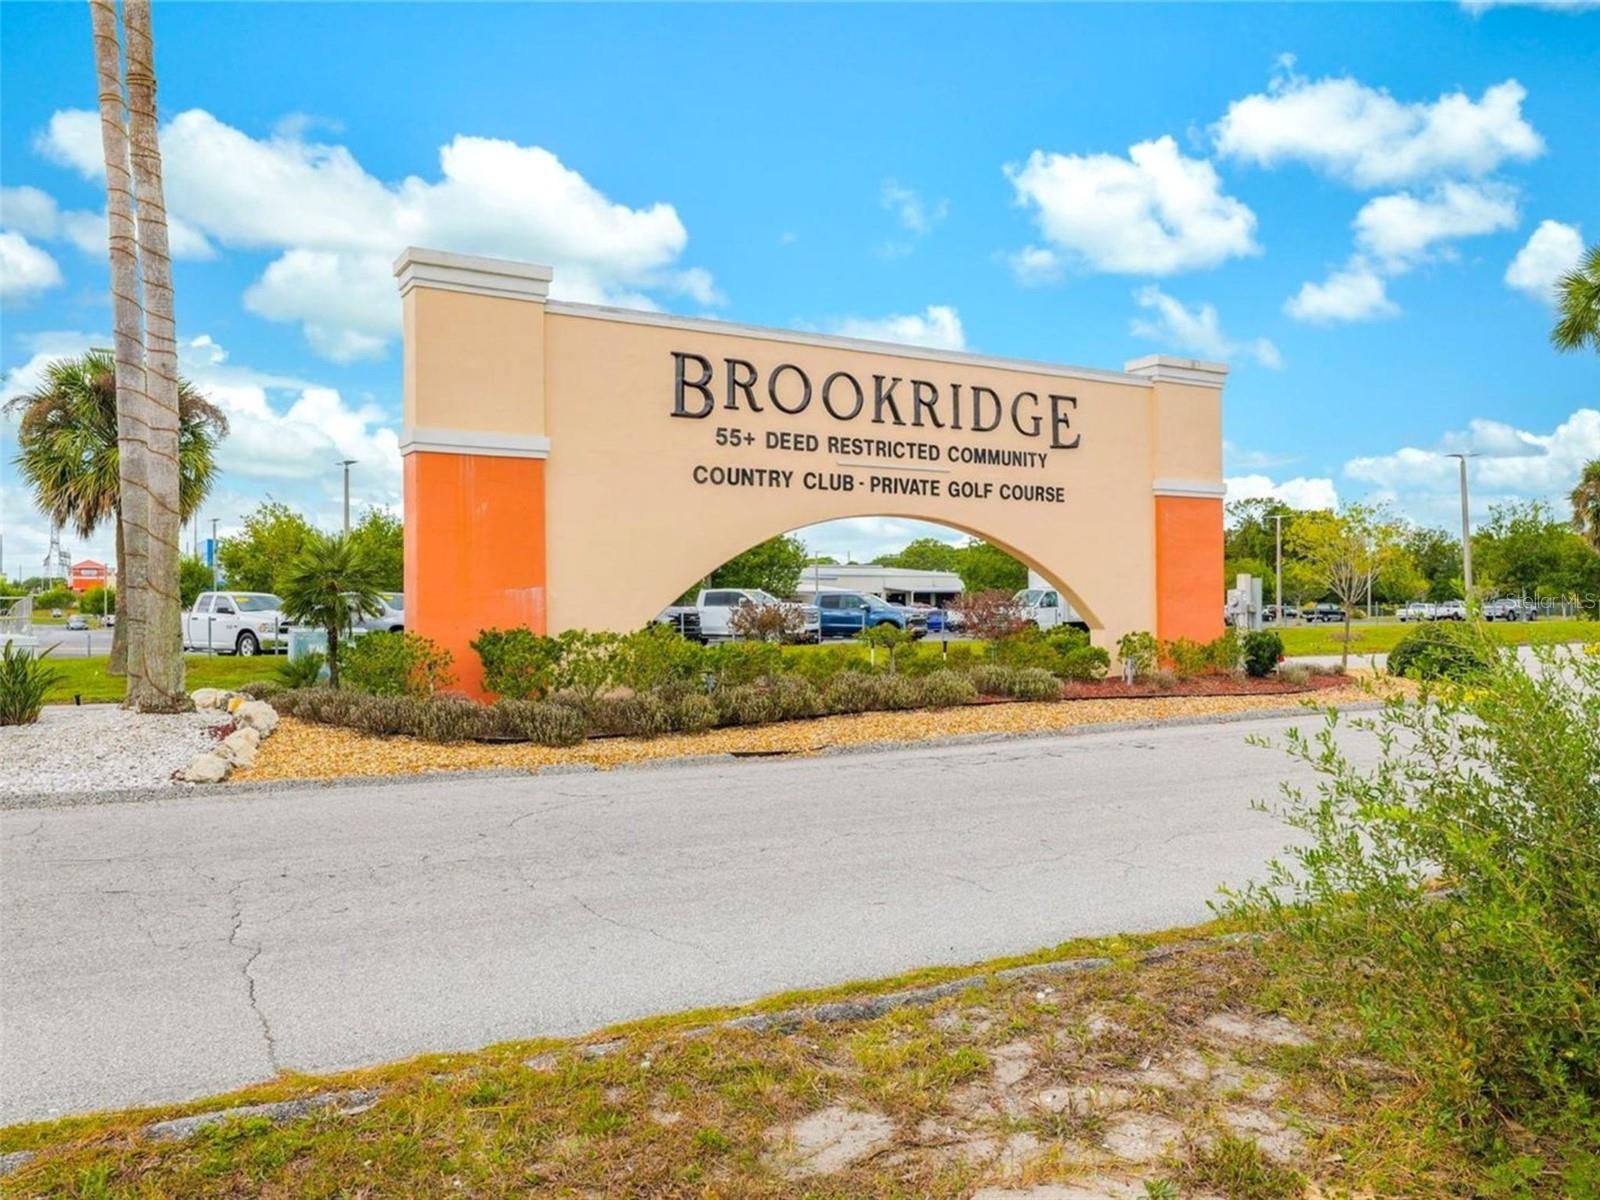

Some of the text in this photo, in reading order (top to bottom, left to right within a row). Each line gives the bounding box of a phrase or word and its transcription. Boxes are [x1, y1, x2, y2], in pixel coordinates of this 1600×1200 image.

[670, 351, 1081, 449] BROOKRIDGE
[715, 427, 1048, 469] 55+ DEED RESTRICTED COMMUNITY
[693, 466, 793, 488] COUNTRY
[803, 472, 854, 491] CLUB
[870, 476, 940, 496] PRIVATE
[948, 481, 993, 499] GOLF
[1000, 485, 1066, 503] COURSE
